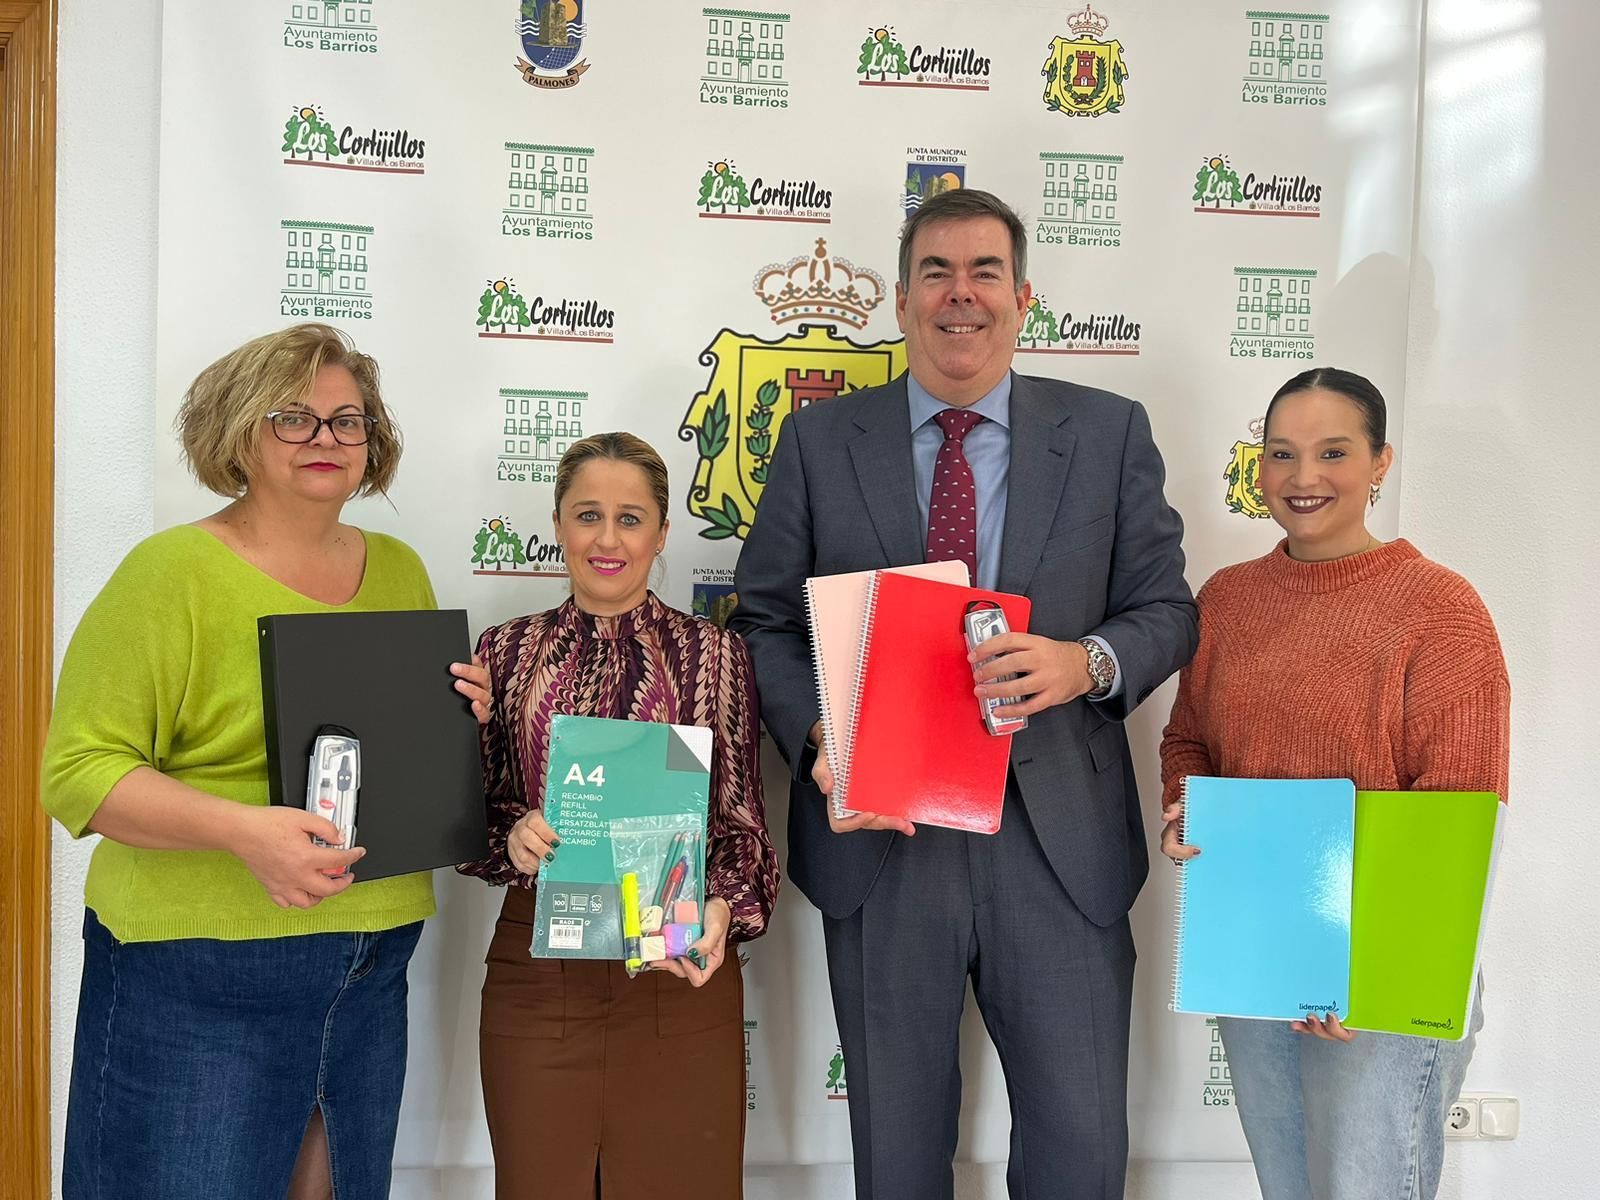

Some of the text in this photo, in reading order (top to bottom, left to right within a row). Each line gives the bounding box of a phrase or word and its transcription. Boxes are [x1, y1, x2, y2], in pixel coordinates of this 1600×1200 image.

[284, 26, 378, 42] Ayuntamiento
[284, 36, 378, 53] Los Barrios
[868, 43, 991, 79] Los Cortijillos
[529, 76, 575, 87] PALMONES
[1242, 82, 1327, 96] Ayuntamiento
[700, 82, 789, 98] Ayuntamiento
[700, 94, 789, 109] Los Barrios
[1242, 93, 1326, 106] Los Barrios
[292, 121, 425, 162] Los Cortijillos
[708, 176, 832, 212] Los Cortijillos
[1203, 171, 1322, 206] Los Cortijillos
[502, 214, 593, 230] Ayuntamiento
[502, 226, 593, 240] Los Barrios
[1036, 223, 1121, 238] Ayuntamiento
[1036, 234, 1121, 247] Los Barrios
[280, 295, 373, 310] Ayuntamiento
[280, 305, 372, 320] Los Barrios
[487, 294, 615, 332] Los Cortijillos
[1020, 311, 1141, 345] Los Cortijillos
[1230, 337, 1314, 350] Ayuntamiento
[1230, 347, 1314, 360] Los Barrios
[498, 472, 526, 481] Los
[482, 532, 514, 561] Los
[563, 763, 606, 787] A4
[562, 792, 603, 801] RECAMBIO
[561, 801, 586, 809] REFILL
[560, 810, 598, 818] RECARGA
[558, 828, 602, 837] RECHARGE
[1204, 1096, 1230, 1106] Los
